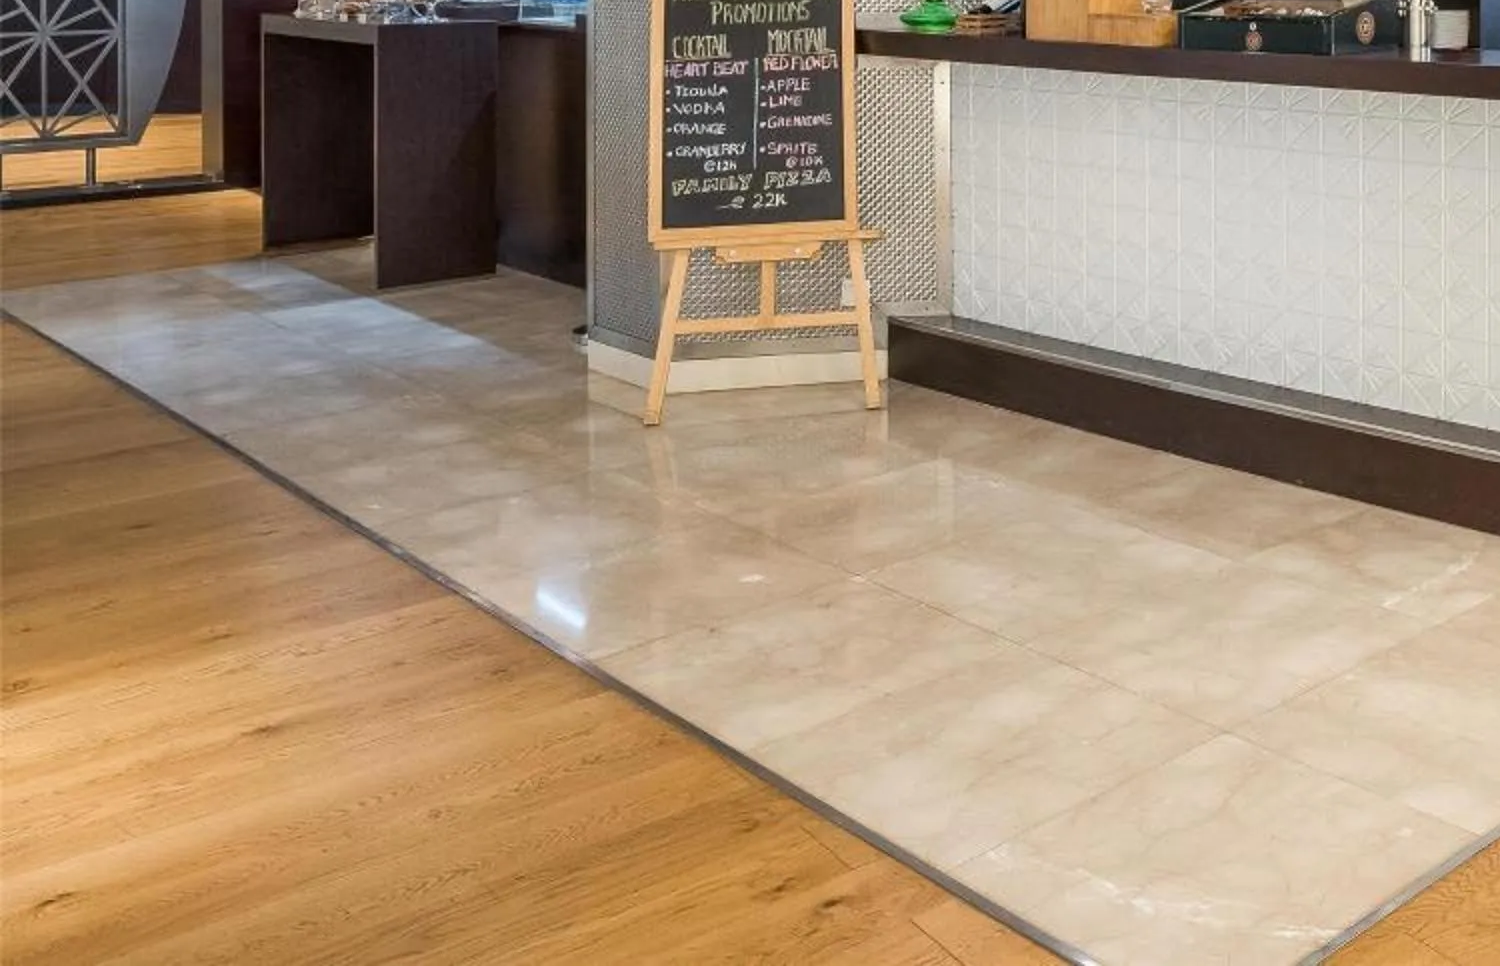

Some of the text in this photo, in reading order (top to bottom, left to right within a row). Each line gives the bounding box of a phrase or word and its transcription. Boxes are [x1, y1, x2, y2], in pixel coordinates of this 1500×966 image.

[710, 0, 812, 25] PROMOTIONS
[672, 33, 732, 59] COCKTAIL
[767, 26, 836, 54] MOCKTAIL
[665, 60, 749, 78] HEART BEAT
[763, 54, 838, 72] RED FLOWER
[767, 77, 810, 92] APPLE
[672, 101, 725, 115] VODKA
[769, 95, 803, 108] LIME
[673, 122, 727, 135] ORANGE
[675, 141, 747, 159] CRANBERRY
[767, 141, 817, 155] SPRITE
[763, 167, 832, 190] PIZZA
[752, 192, 788, 209] 22K
